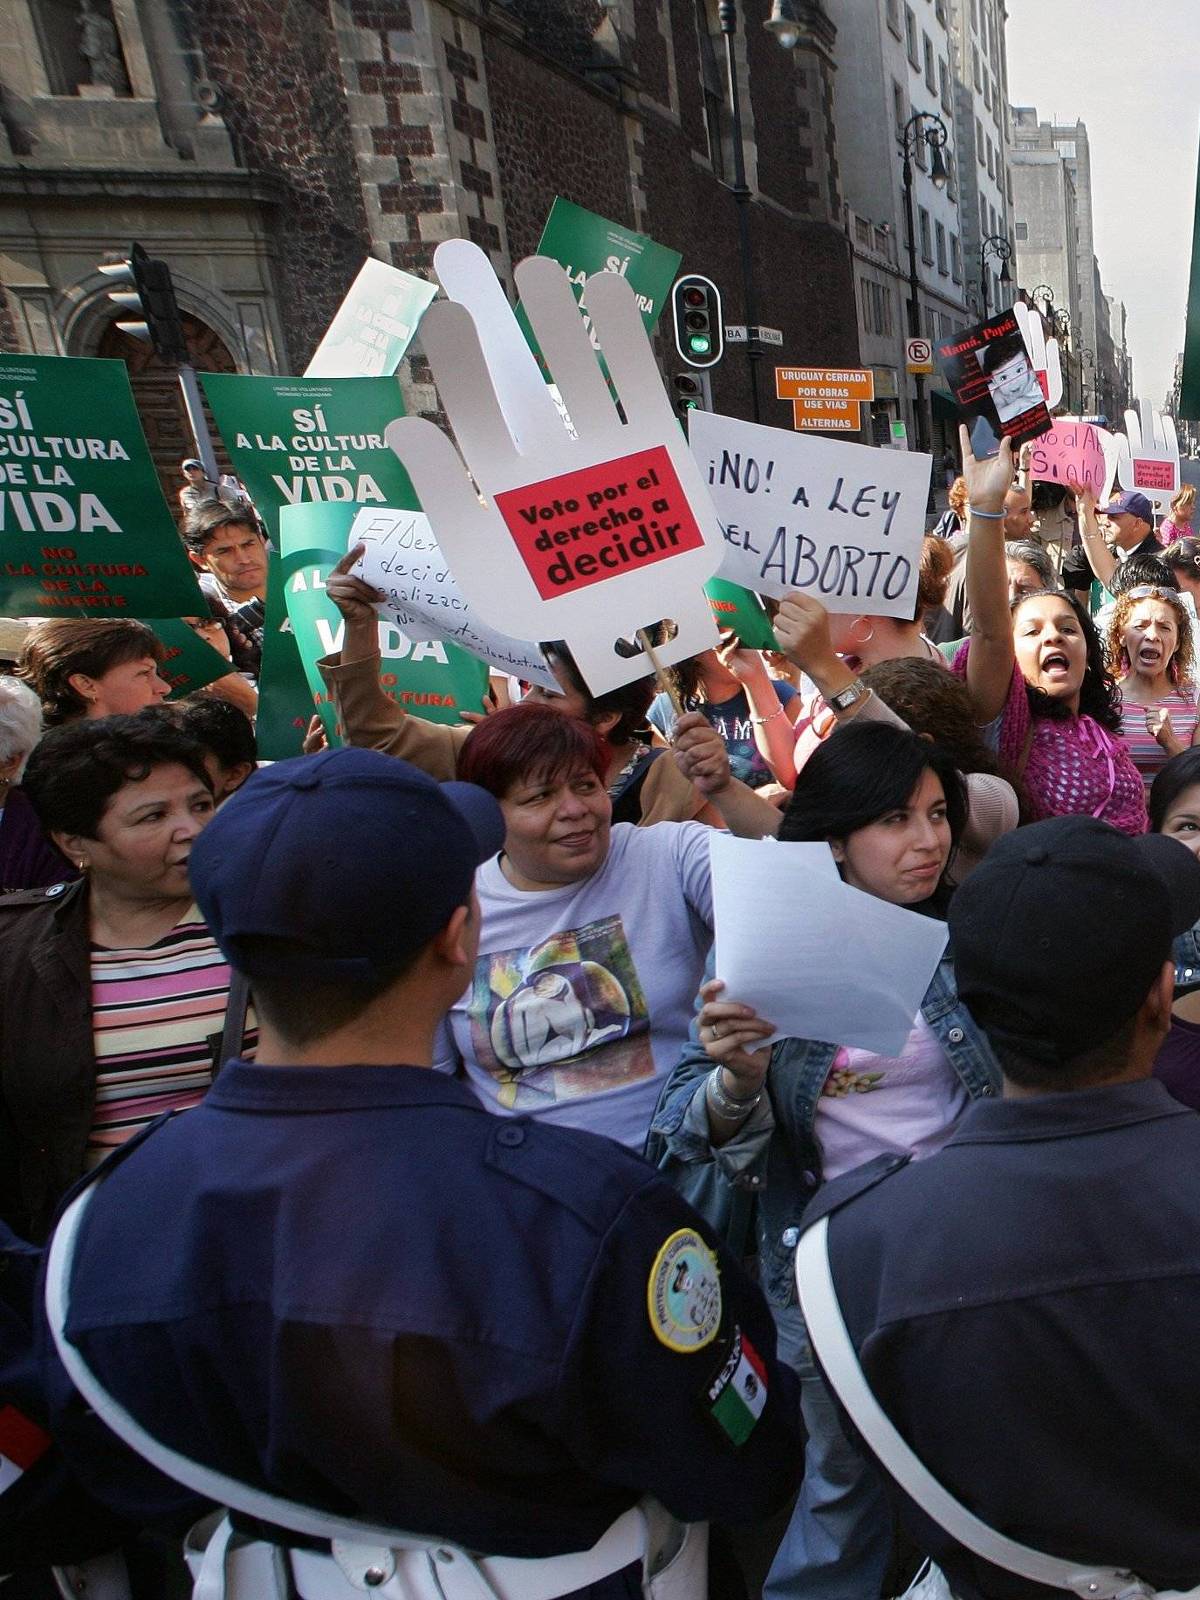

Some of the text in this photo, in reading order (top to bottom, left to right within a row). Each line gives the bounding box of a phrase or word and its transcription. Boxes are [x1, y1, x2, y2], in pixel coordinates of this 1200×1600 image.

[566, 265, 587, 287] LA
[781, 371, 866, 382] URUGUAY CERRADA
[797, 387, 849, 397] POR OBRAS
[804, 400, 823, 409] USE
[293, 404, 328, 432] SÍ
[800, 418, 851, 427] ALTERNAS
[237, 433, 390, 451] A LA CULTUR
[289, 456, 356, 471] DE LA
[32, 464, 75, 486] LA
[1137, 477, 1171, 488] decidir
[272, 474, 388, 504] VIDA
[518, 469, 660, 524] Voto por el
[708, 450, 901, 536] ¡NO! A LEY
[0, 491, 123, 533] IDA
[535, 498, 670, 552] derecho a
[40, 547, 76, 560] NO
[547, 521, 681, 585] decidir
[760, 526, 911, 600] ABORTO
[5, 564, 149, 576] LA CULTURA
[41, 580, 108, 592] DE LA
[293, 569, 326, 592] A L
[37, 595, 127, 607] MUERTE
[316, 618, 449, 664] VDA
[379, 672, 397, 686] O
